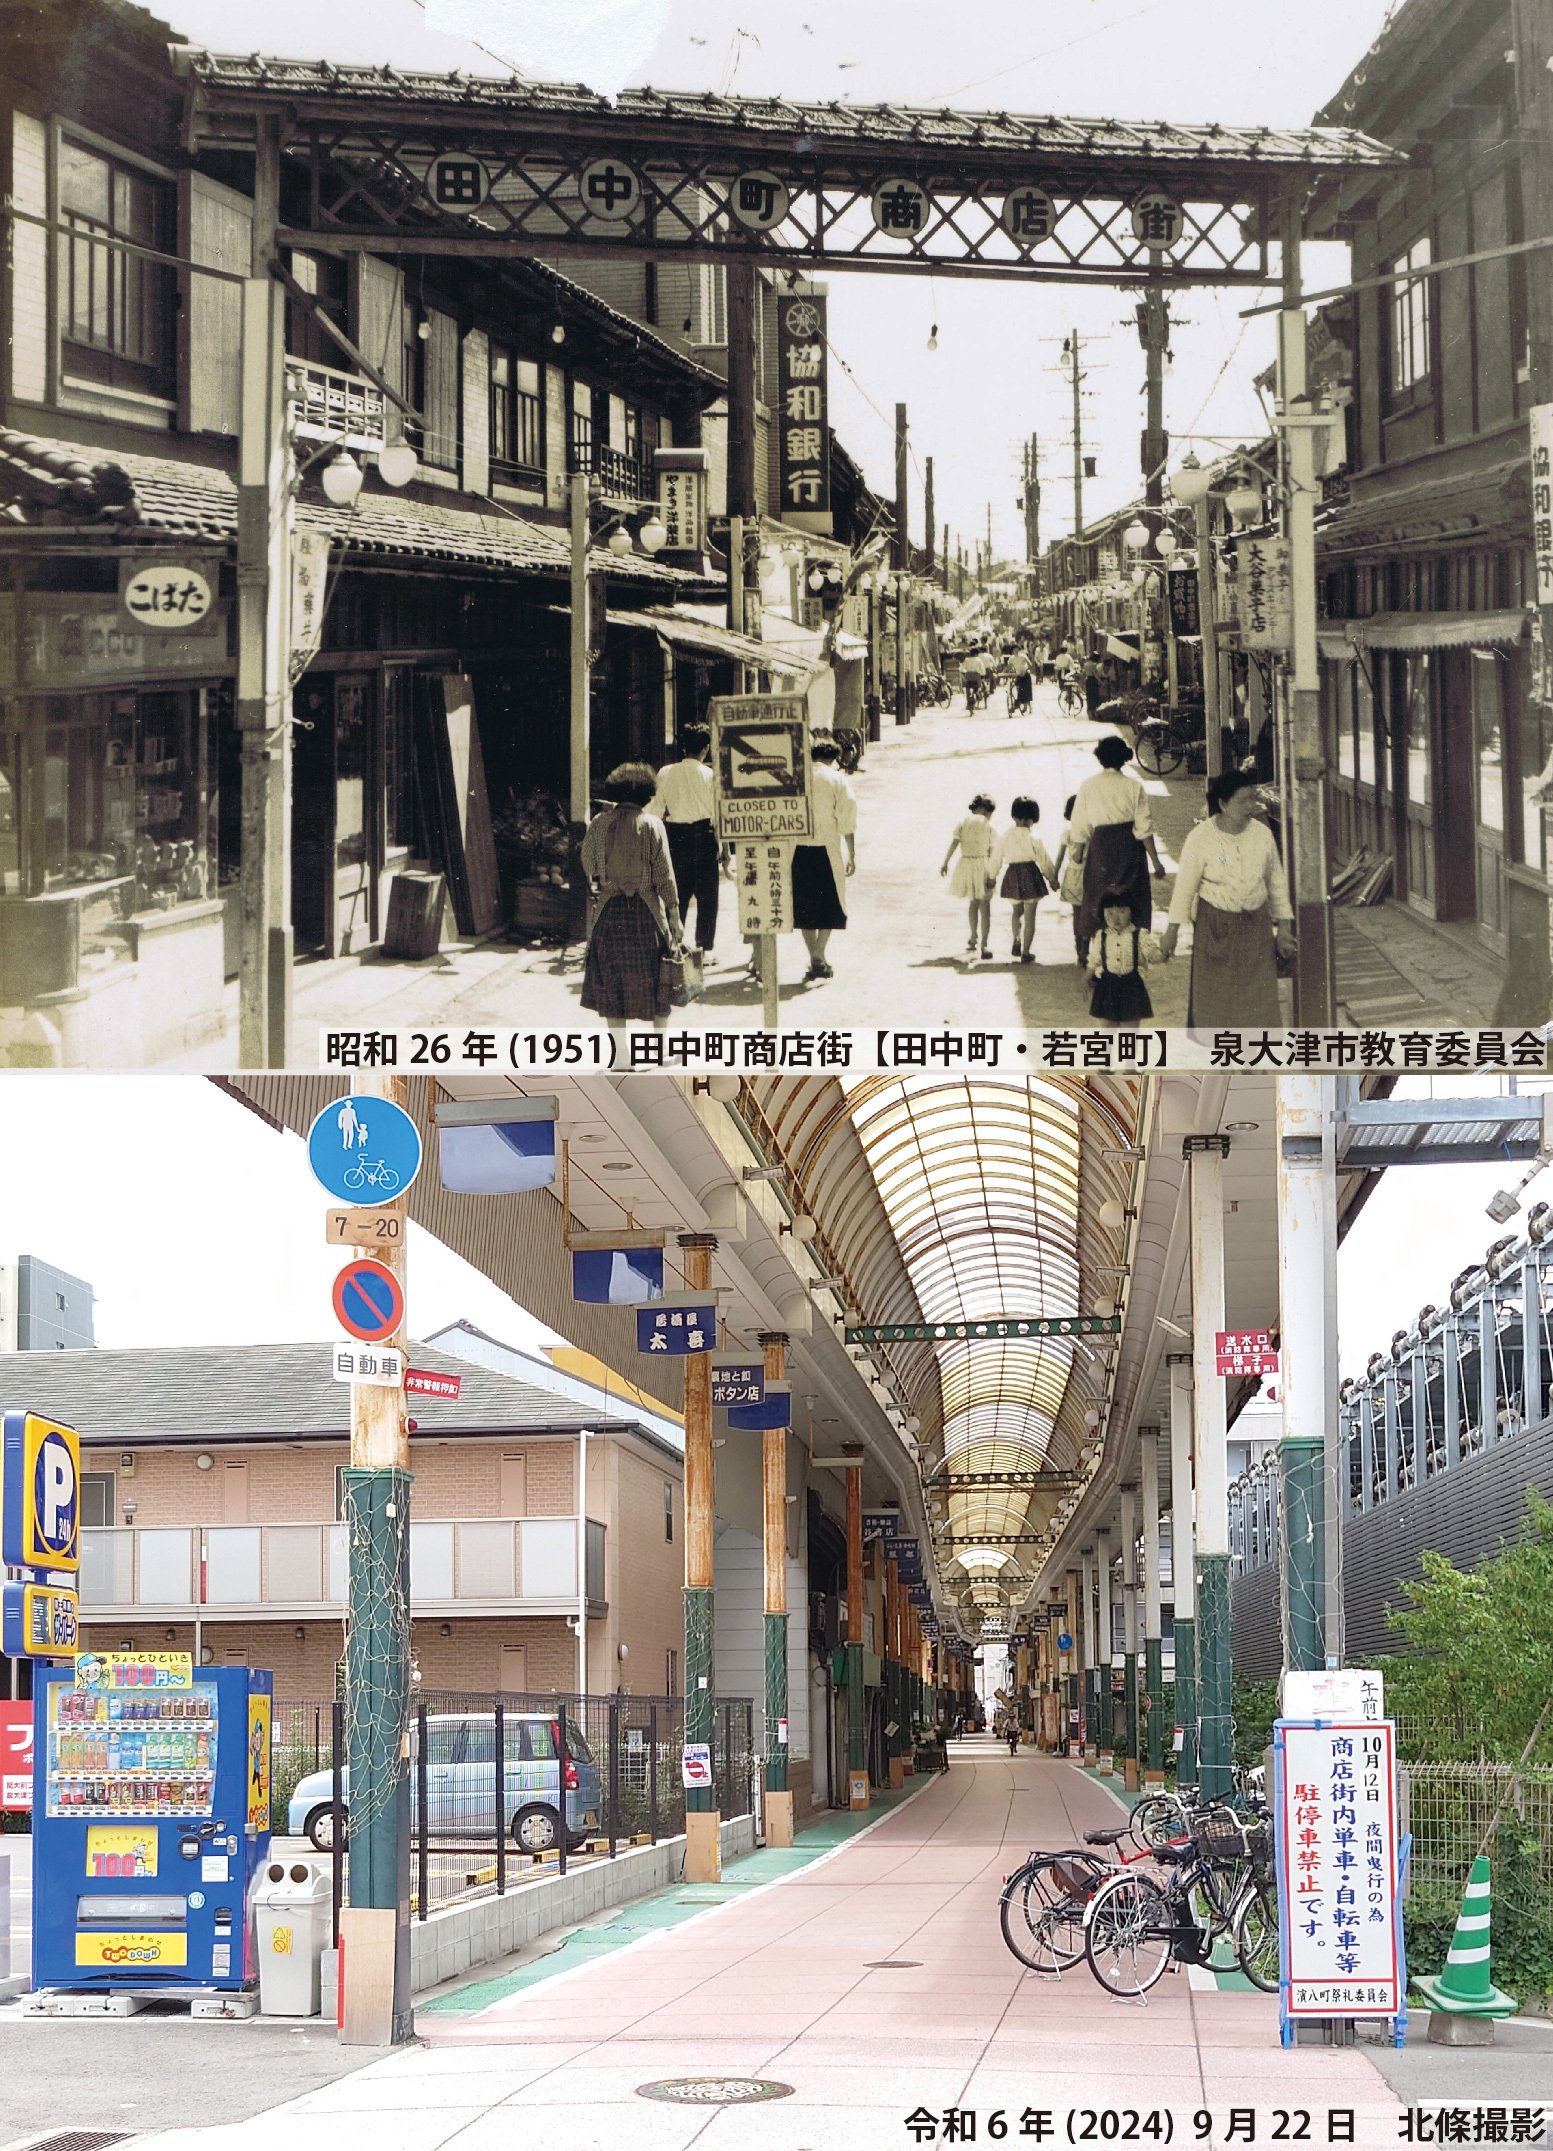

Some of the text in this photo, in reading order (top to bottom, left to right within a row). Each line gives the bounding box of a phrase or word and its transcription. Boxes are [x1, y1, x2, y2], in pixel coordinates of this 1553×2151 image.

[437, 161, 1177, 243] 田中町商店街
[786, 344, 822, 503] 協和銀行
[129, 581, 205, 614] こばた
[1247, 543, 1267, 633] 大谷菓子店
[722, 704, 798, 723] 自動車通行止
[728, 799, 798, 813] CLOSED TO
[724, 814, 805, 834] MOTOR-CARS
[767, 847, 784, 929] 自午前八時三十分
[656, 1312, 698, 1327] 居酒屋
[1226, 1334, 1267, 1347] 送水口
[338, 1352, 398, 1377] 自動車
[714, 1385, 760, 1401] ボタン店
[44, 1440, 75, 1539] P
[112, 1653, 189, 1663] ちょっとひといき
[1362, 1736, 1384, 1923] 10月12日 夜間曳行の為
[1293, 1784, 1326, 1947] 駐停車禁止です。
[1329, 1736, 1361, 1974] 商店街内単車・自転車等
[129, 1947, 159, 1961] DOWN
